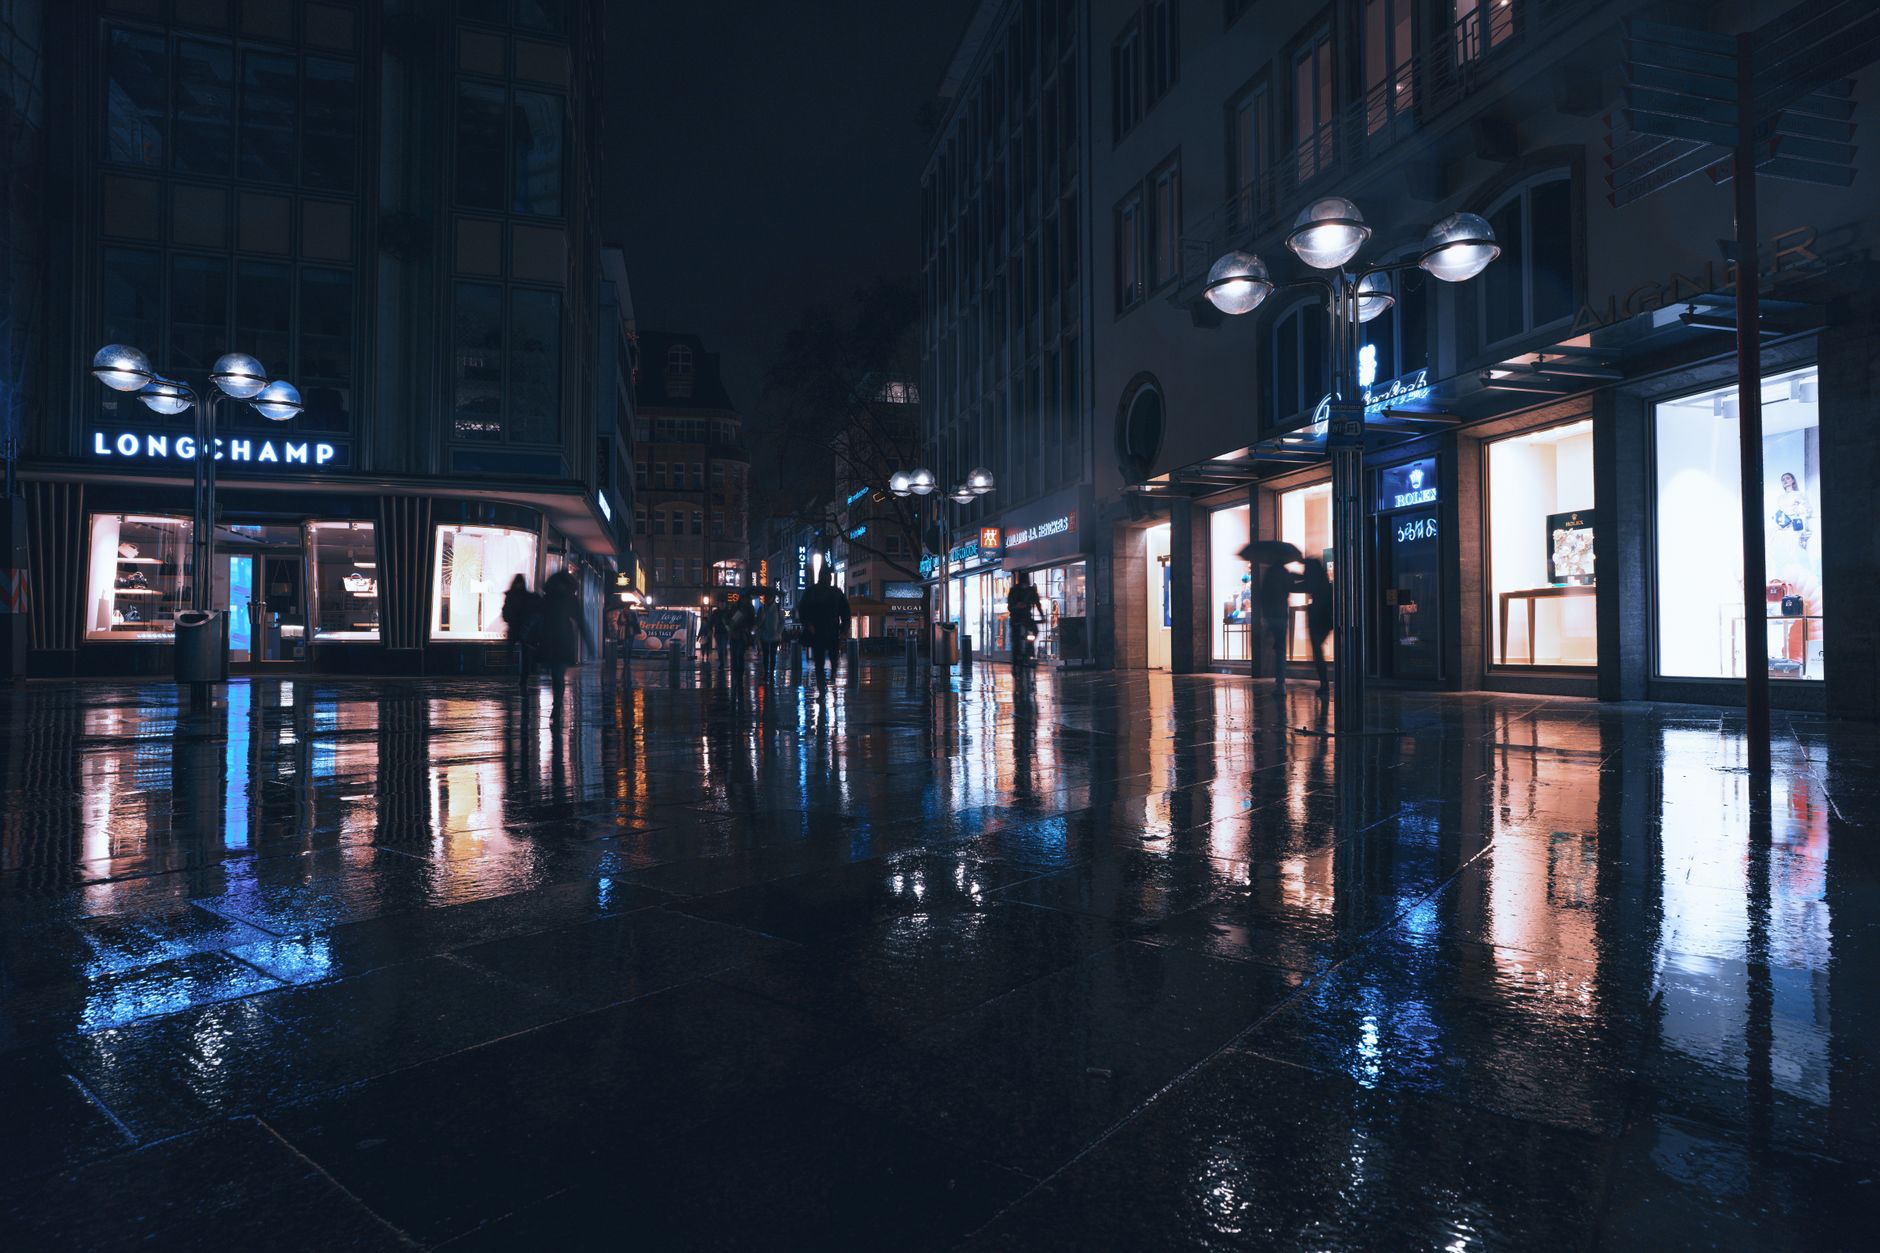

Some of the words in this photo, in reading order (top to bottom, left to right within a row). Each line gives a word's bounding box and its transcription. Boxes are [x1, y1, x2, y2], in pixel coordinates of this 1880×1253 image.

[95, 432, 336, 464] LONGCHAMP
[1394, 488, 1437, 508] ROLEX
[798, 546, 806, 585] HOTEL
[640, 620, 681, 630] Berliner
